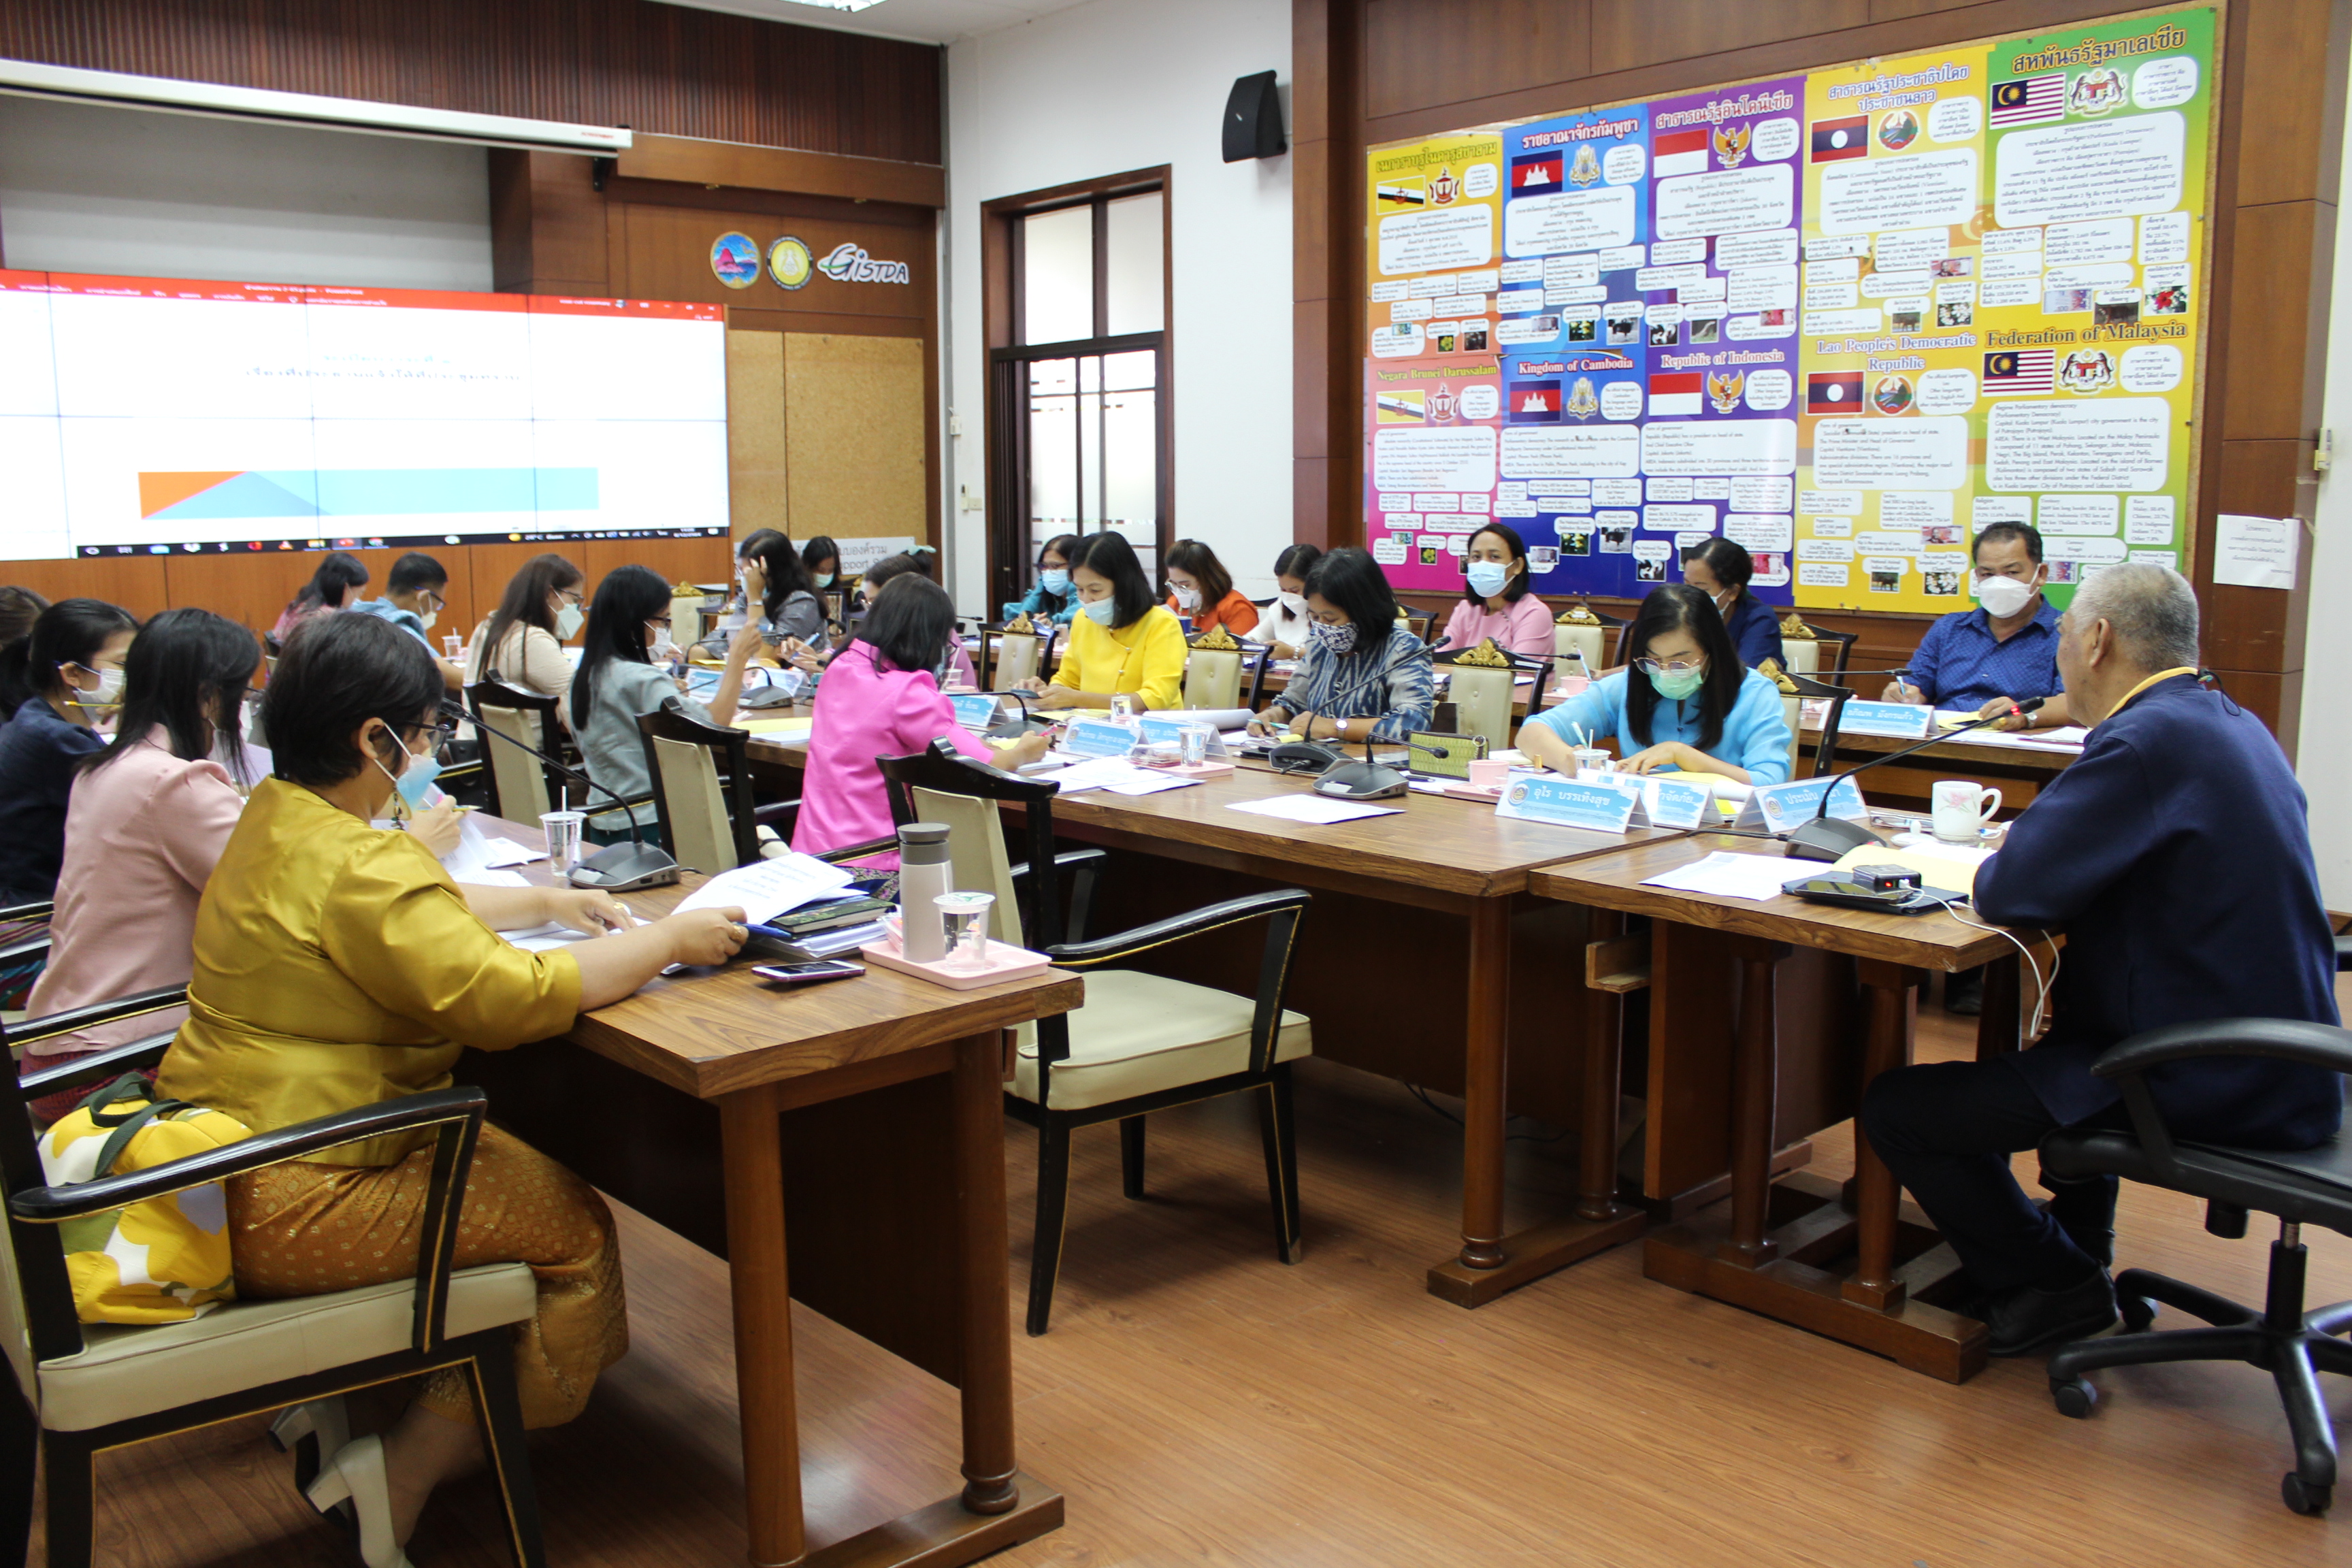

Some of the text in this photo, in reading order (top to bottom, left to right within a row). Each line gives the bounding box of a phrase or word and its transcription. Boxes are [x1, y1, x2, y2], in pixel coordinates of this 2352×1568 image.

[2012, 24, 2186, 74] สหพันธรัฐมาเลเซีย
[1655, 91, 1793, 129] สาธารณรัฐอินโดนีเซีย
[1858, 89, 1936, 113] ประชาชนลาว
[1522, 117, 1639, 150] ราชอาณาจักรกัมพูชา
[1817, 333, 1976, 354] Lao People's Democratic
[1986, 321, 2187, 347] Federation of Malaysia
[1518, 357, 1633, 376] Kingdom of Cambodia
[1661, 349, 1785, 370] Republic of Indonesia
[1868, 355, 1925, 373] Republic
[1377, 365, 1497, 382] Negara Brunei Darussalam
[1534, 785, 1551, 800] อุไร
